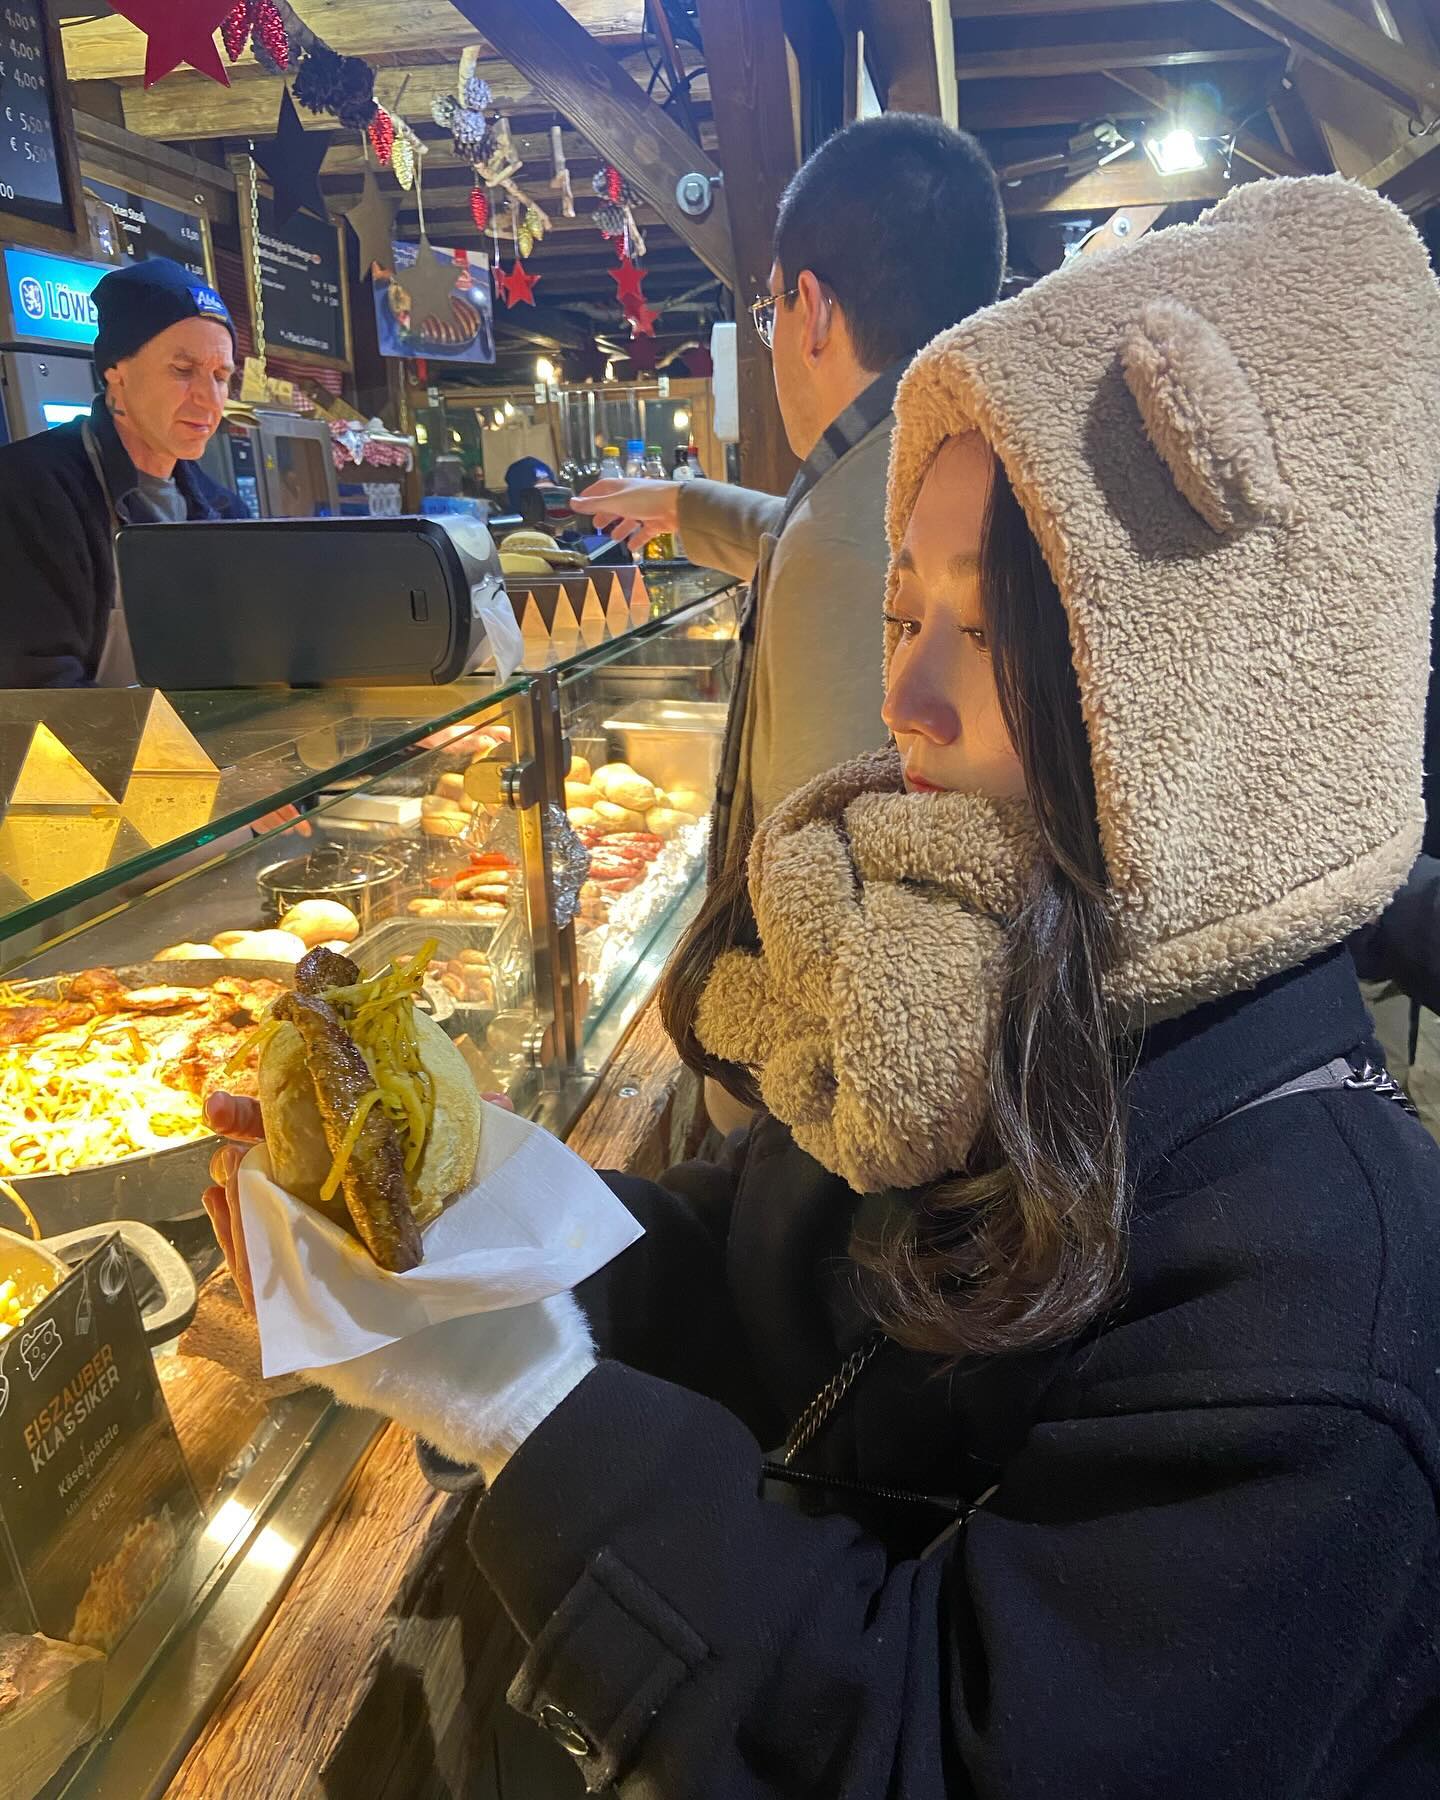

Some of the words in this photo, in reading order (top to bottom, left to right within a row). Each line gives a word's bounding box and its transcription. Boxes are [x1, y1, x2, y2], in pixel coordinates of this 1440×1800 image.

[5, 106, 13, 121] €
[10, 136, 18, 152] €
[46, 281, 98, 324] LÖWE
[23, 1343, 114, 1451] EISZAUBER
[30, 1364, 121, 1474] KLASSIKER
